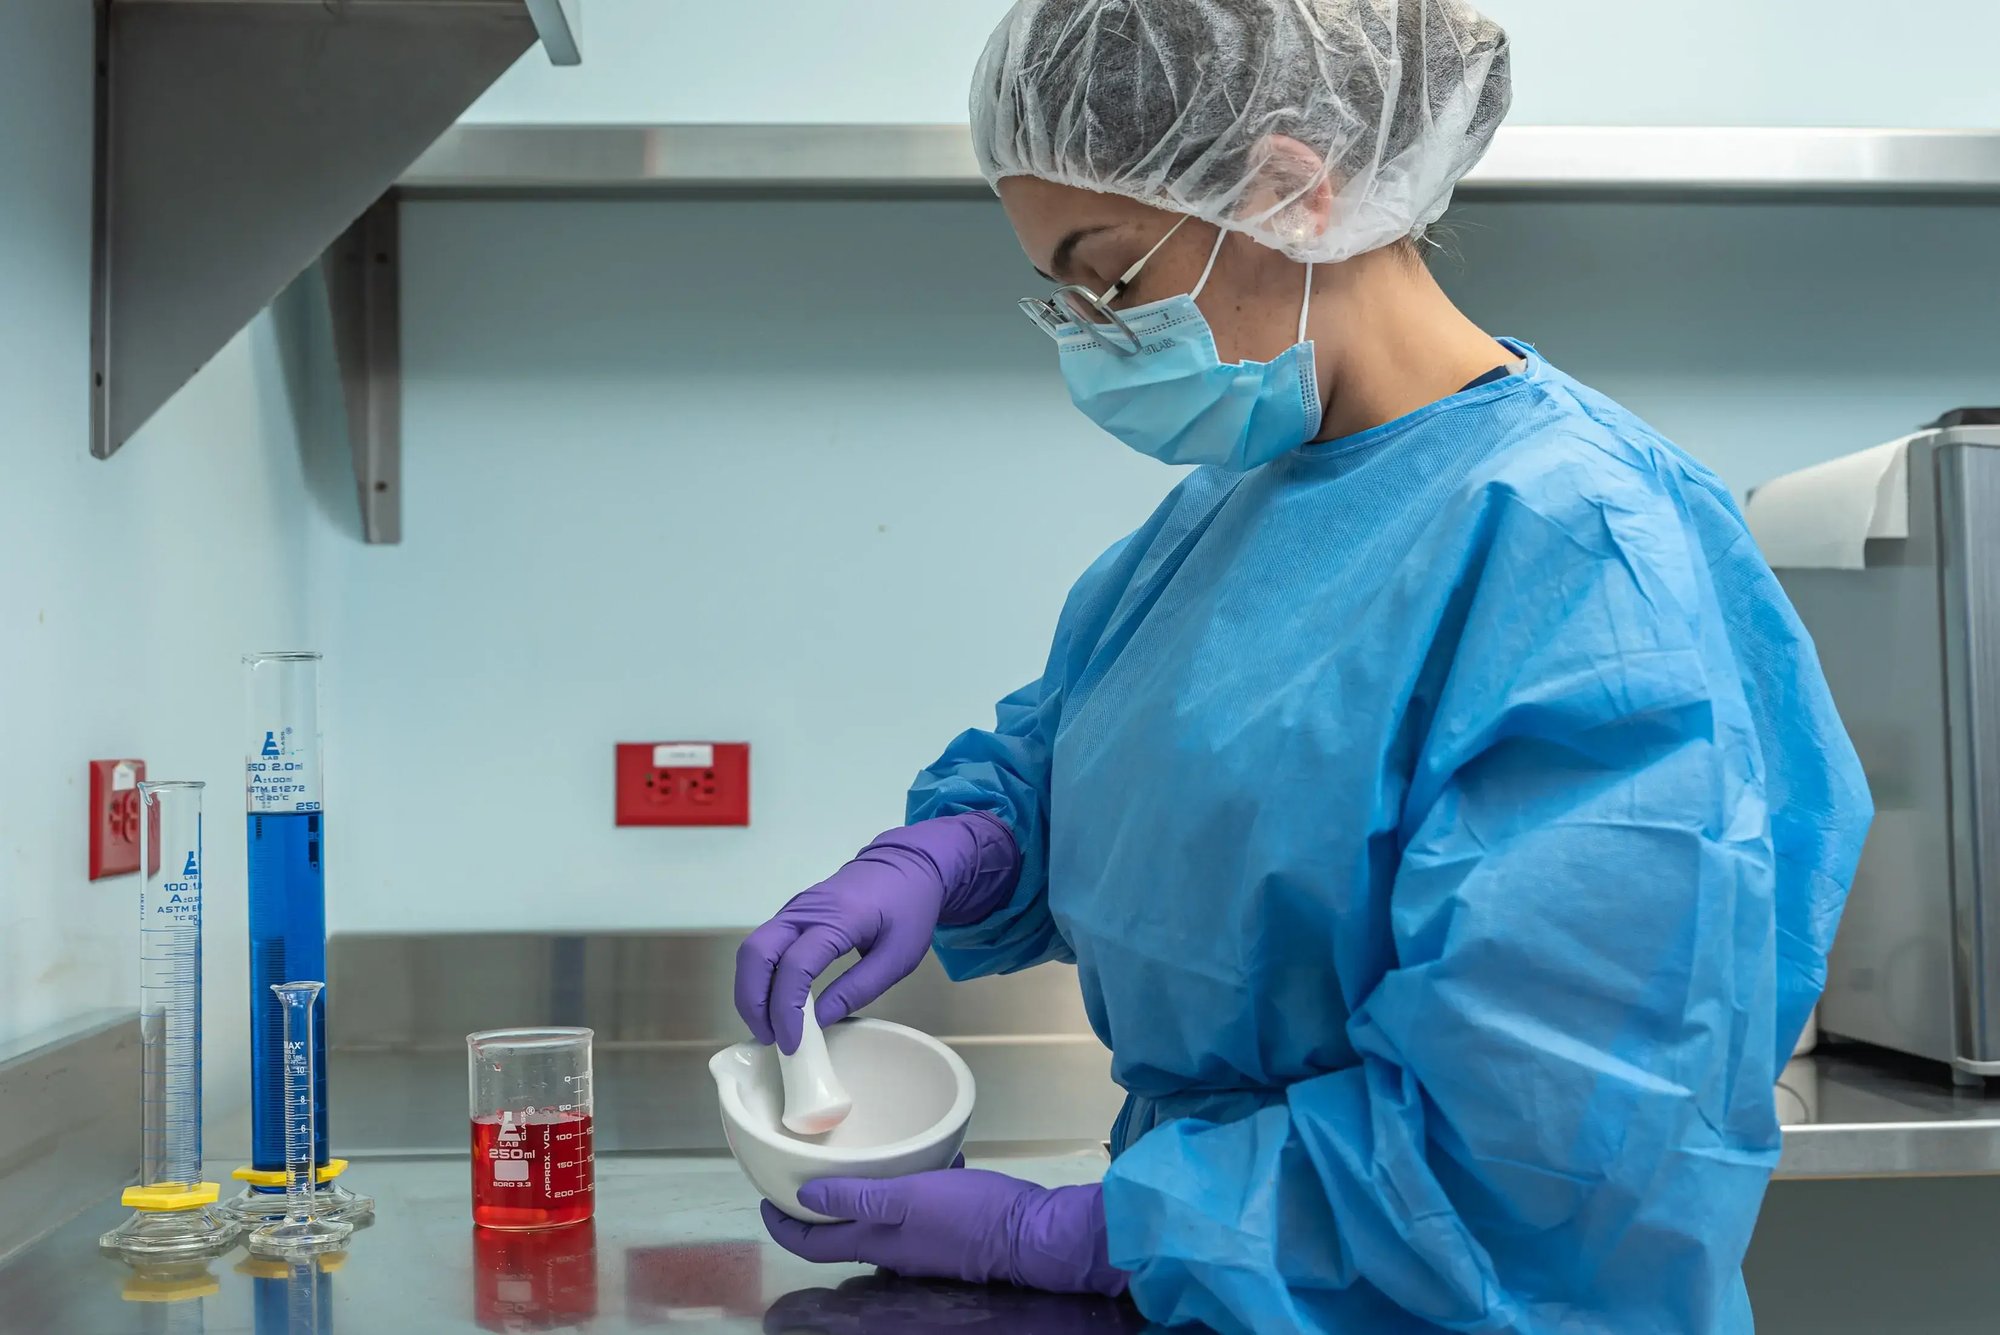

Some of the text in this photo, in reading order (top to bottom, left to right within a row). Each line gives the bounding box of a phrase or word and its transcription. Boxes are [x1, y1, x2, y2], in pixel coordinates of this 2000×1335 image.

[296, 801, 321, 811] 250
[170, 894, 183, 904] A
[157, 905, 190, 914] ASTM
[297, 1066, 305, 1075] 10
[300, 1095, 306, 1104] 8
[559, 1103, 572, 1112] 50
[300, 1124, 307, 1133] 6
[556, 1133, 573, 1141] 100
[301, 1153, 307, 1162] 4
[557, 1161, 573, 1169] 150
[543, 1152, 552, 1198] APPROX.
[554, 1189, 574, 1199] 200
